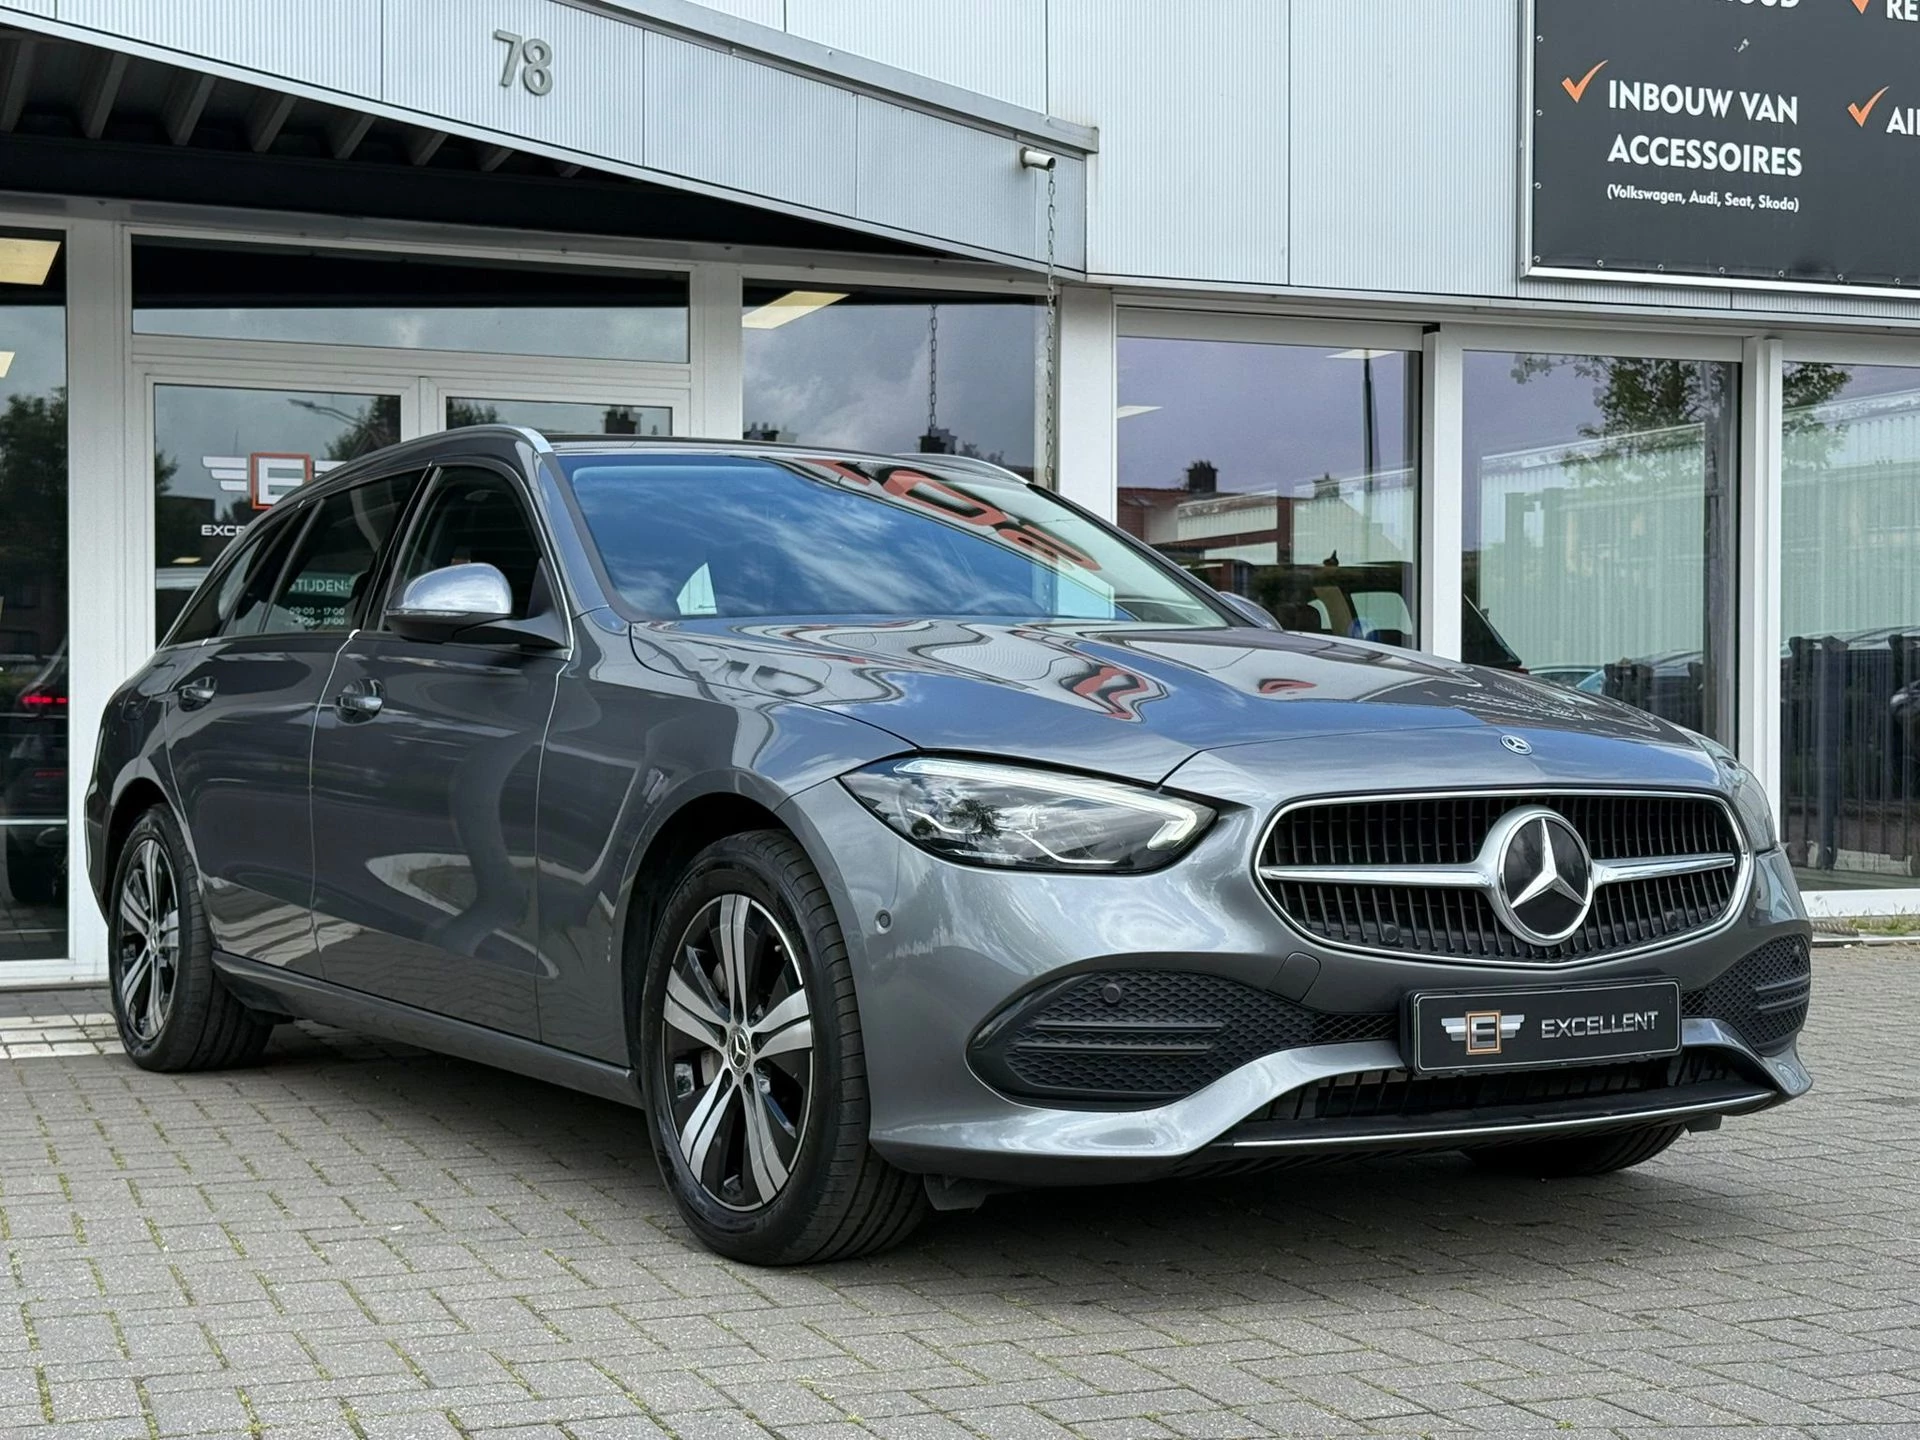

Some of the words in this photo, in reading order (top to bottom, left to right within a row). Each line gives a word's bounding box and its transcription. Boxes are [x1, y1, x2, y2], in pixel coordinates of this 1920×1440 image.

[492, 29, 553, 96] 78
[1609, 80, 1733, 118] INBOUW
[1739, 91, 1798, 125] VAN
[1607, 134, 1802, 177] ACCESSOIRES
[1607, 184, 1686, 204] (Volkswagen,
[1689, 190, 1721, 207] Audi,
[1724, 193, 1755, 210] Seat,
[1758, 195, 1800, 212] Skoda)
[1541, 1011, 1659, 1039] EXCELLENT
